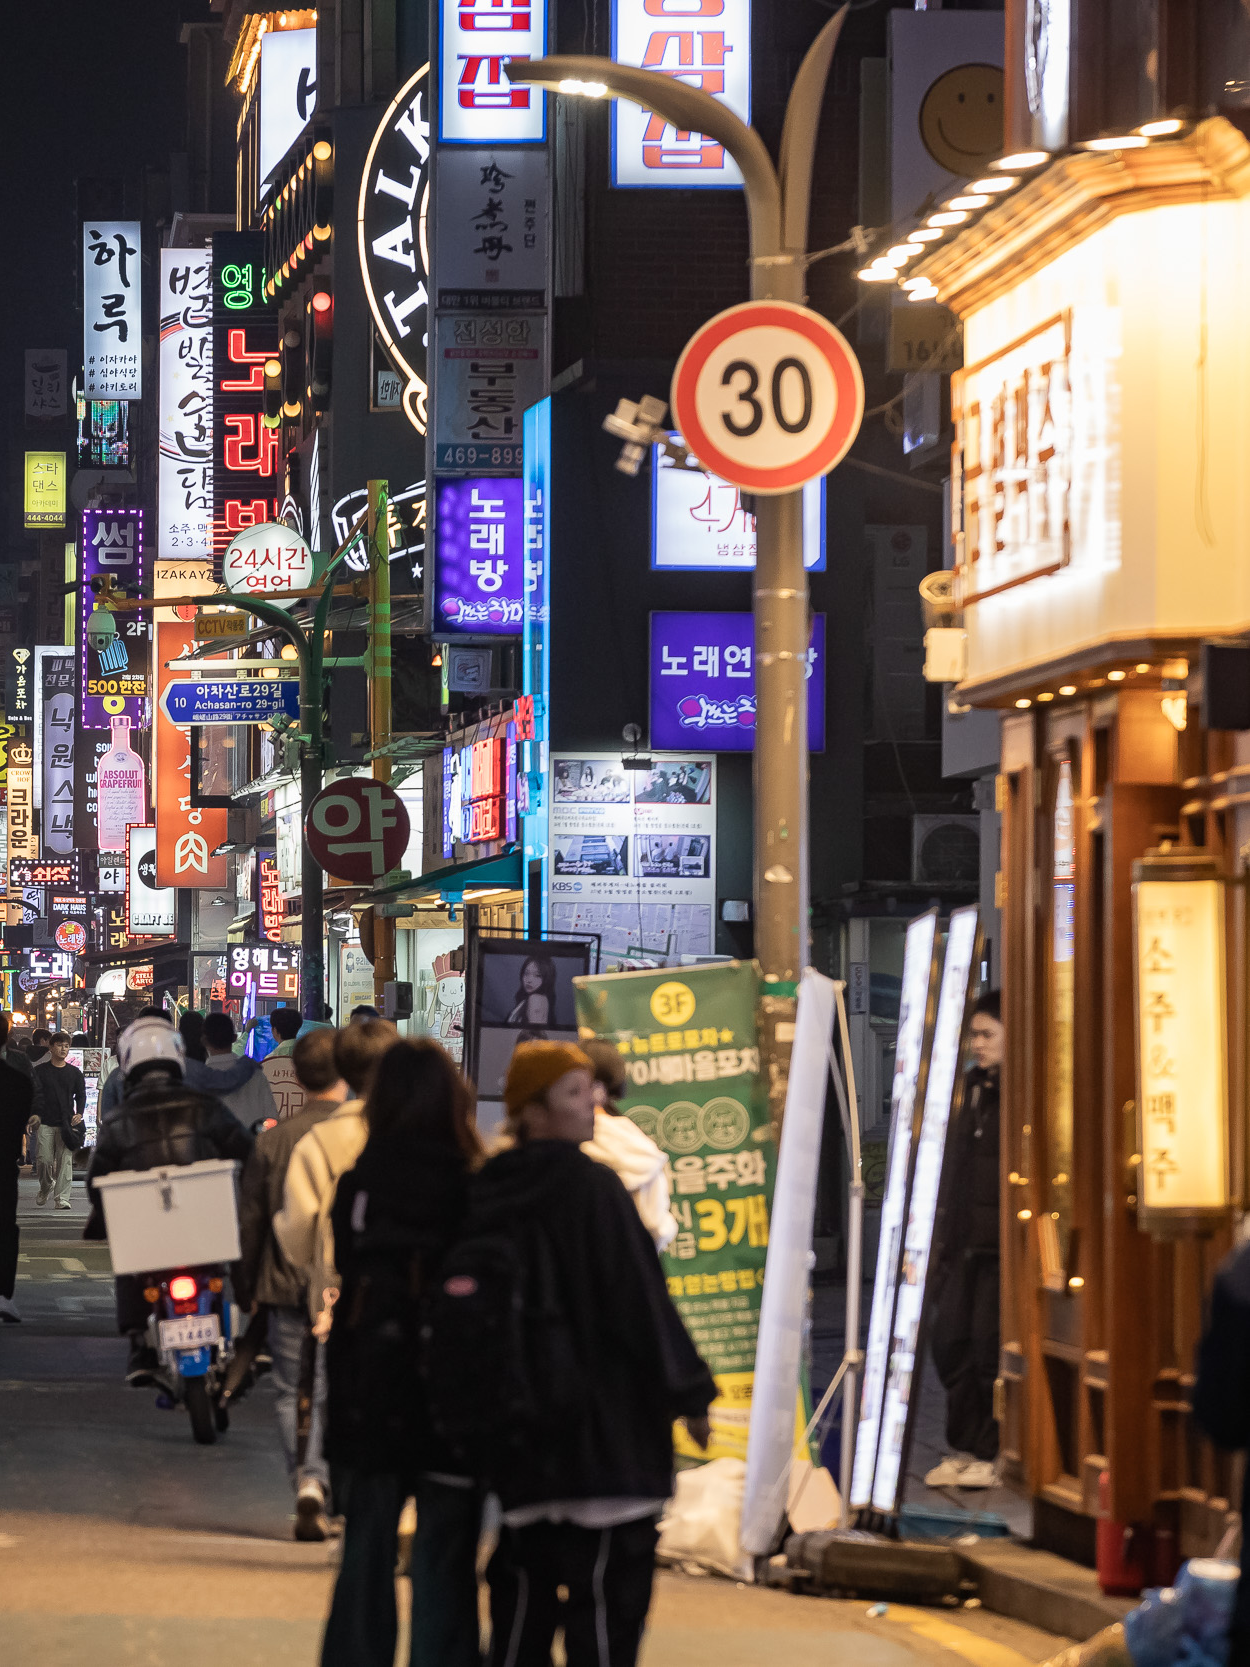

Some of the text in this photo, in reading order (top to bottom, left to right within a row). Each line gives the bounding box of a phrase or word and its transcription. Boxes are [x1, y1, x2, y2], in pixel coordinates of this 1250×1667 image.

[87, 229, 138, 343] 하루
[99, 354, 138, 365] 이자카야
[99, 367, 138, 378] 심야식당
[99, 381, 138, 393] 야키토리
[466, 361, 518, 441] 부동산
[720, 357, 815, 438] 30
[32, 462, 58, 476] 스타
[32, 480, 58, 493] 댄스
[91, 522, 134, 565] 썸
[469, 488, 509, 592] 노래방
[229, 546, 308, 571] 24시간
[126, 622, 146, 636] 2F
[197, 619, 226, 635] CCTV
[87, 679, 146, 694] 500 한잔
[196, 683, 283, 699] 아차산로29길
[174, 697, 187, 709] 10
[194, 699, 285, 711] Achasan-ro 29-gil
[103, 770, 138, 780] ABSOLUT
[100, 779, 142, 789] GRAPEFRUIT
[311, 786, 398, 876] 약
[552, 881, 573, 891] KBS
[53, 903, 86, 911] DARK HAUS
[131, 913, 161, 926] CRAFT
[658, 991, 688, 1017] 3F
[694, 1194, 770, 1252] 3개
